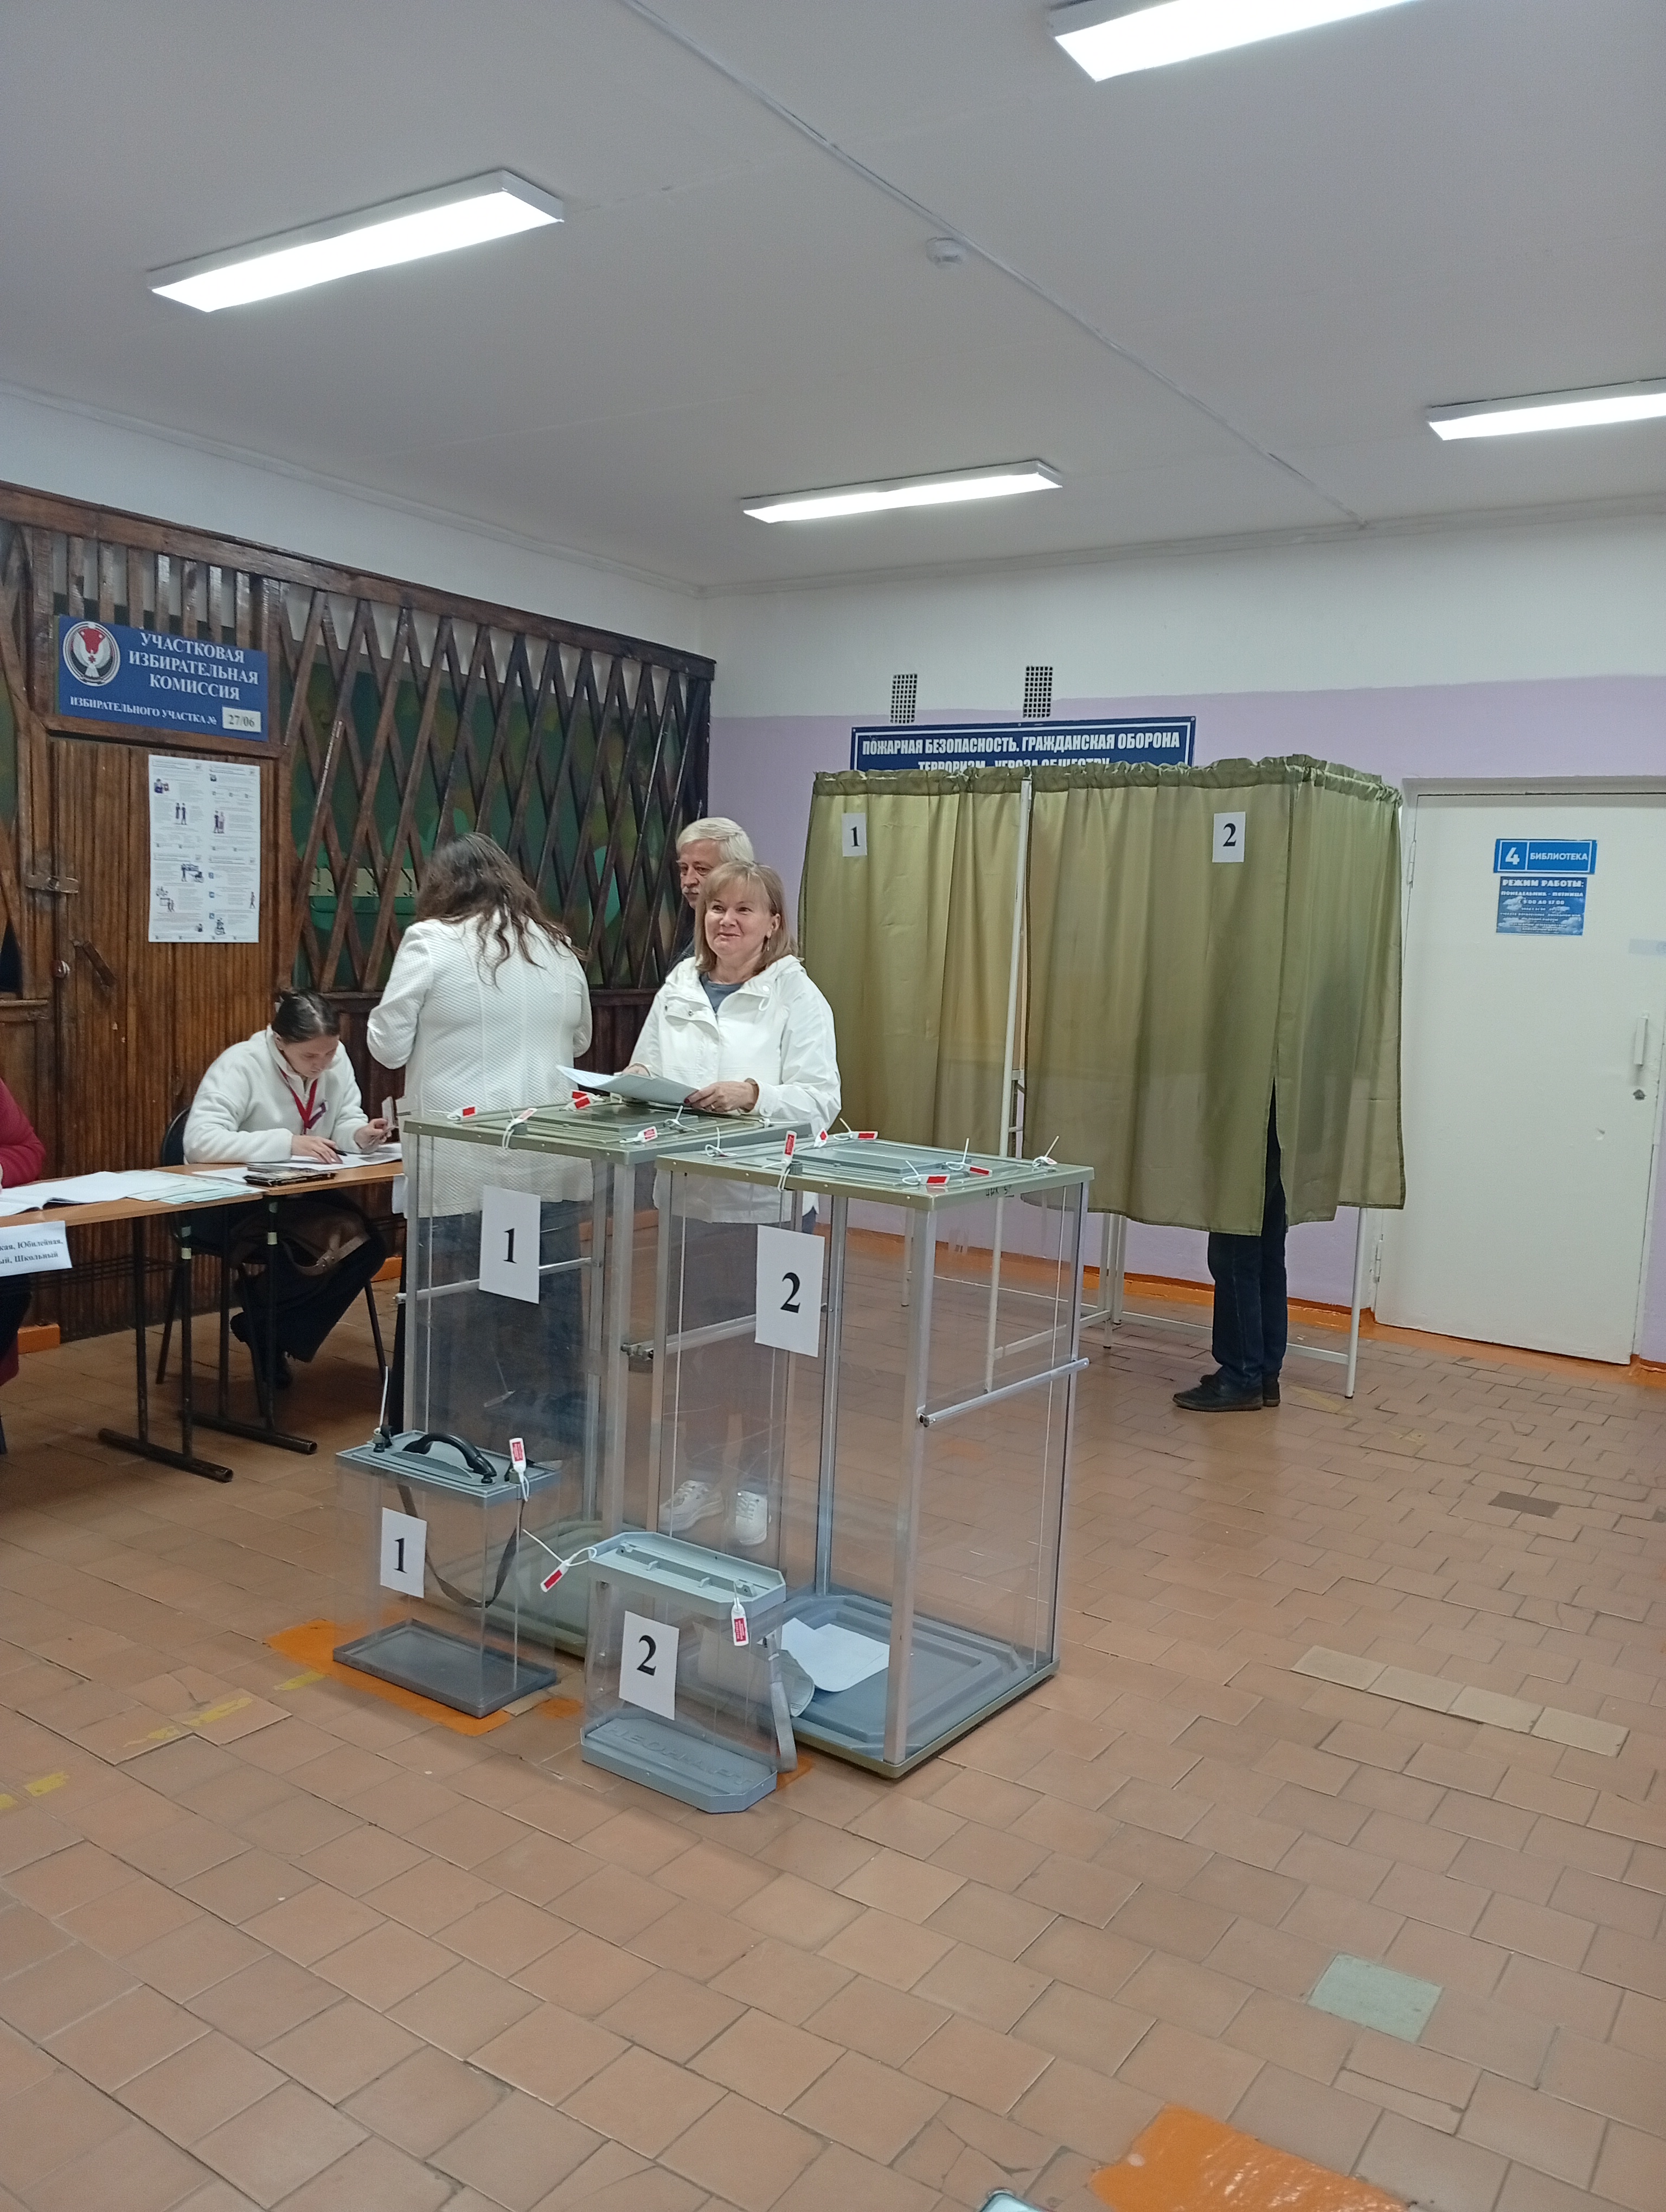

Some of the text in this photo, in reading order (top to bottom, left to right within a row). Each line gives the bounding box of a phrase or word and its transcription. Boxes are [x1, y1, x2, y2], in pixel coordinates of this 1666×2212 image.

[140, 632, 245, 663] УЧАСТКОВАЯ
[129, 651, 259, 685] ИЗБИРАТЕЛЬНАЯ
[150, 674, 240, 700] КОМИССИЯ
[70, 696, 160, 717] ИЗБИРАТЕЛЬНОГО
[162, 709, 206, 724] УЧАСТКА
[862, 732, 1180, 755] ПОЖАРНАЯ БЕЗОПАСНОСТЬ. ГРАЖДАНСКАЯ ОБОРОНА
[850, 826, 860, 847] 1
[1222, 823, 1236, 847] 2
[1505, 847, 1588, 865] 4 БИБЛИОТЕКА
[1502, 879, 1584, 888] РЕЖИМ РАБОТЫ:
[15, 1251, 58, 1263] Школьный
[503, 1227, 517, 1264] 1
[780, 1272, 800, 1314] 2
[394, 1538, 408, 1574] 1
[637, 1635, 657, 1676] 2
